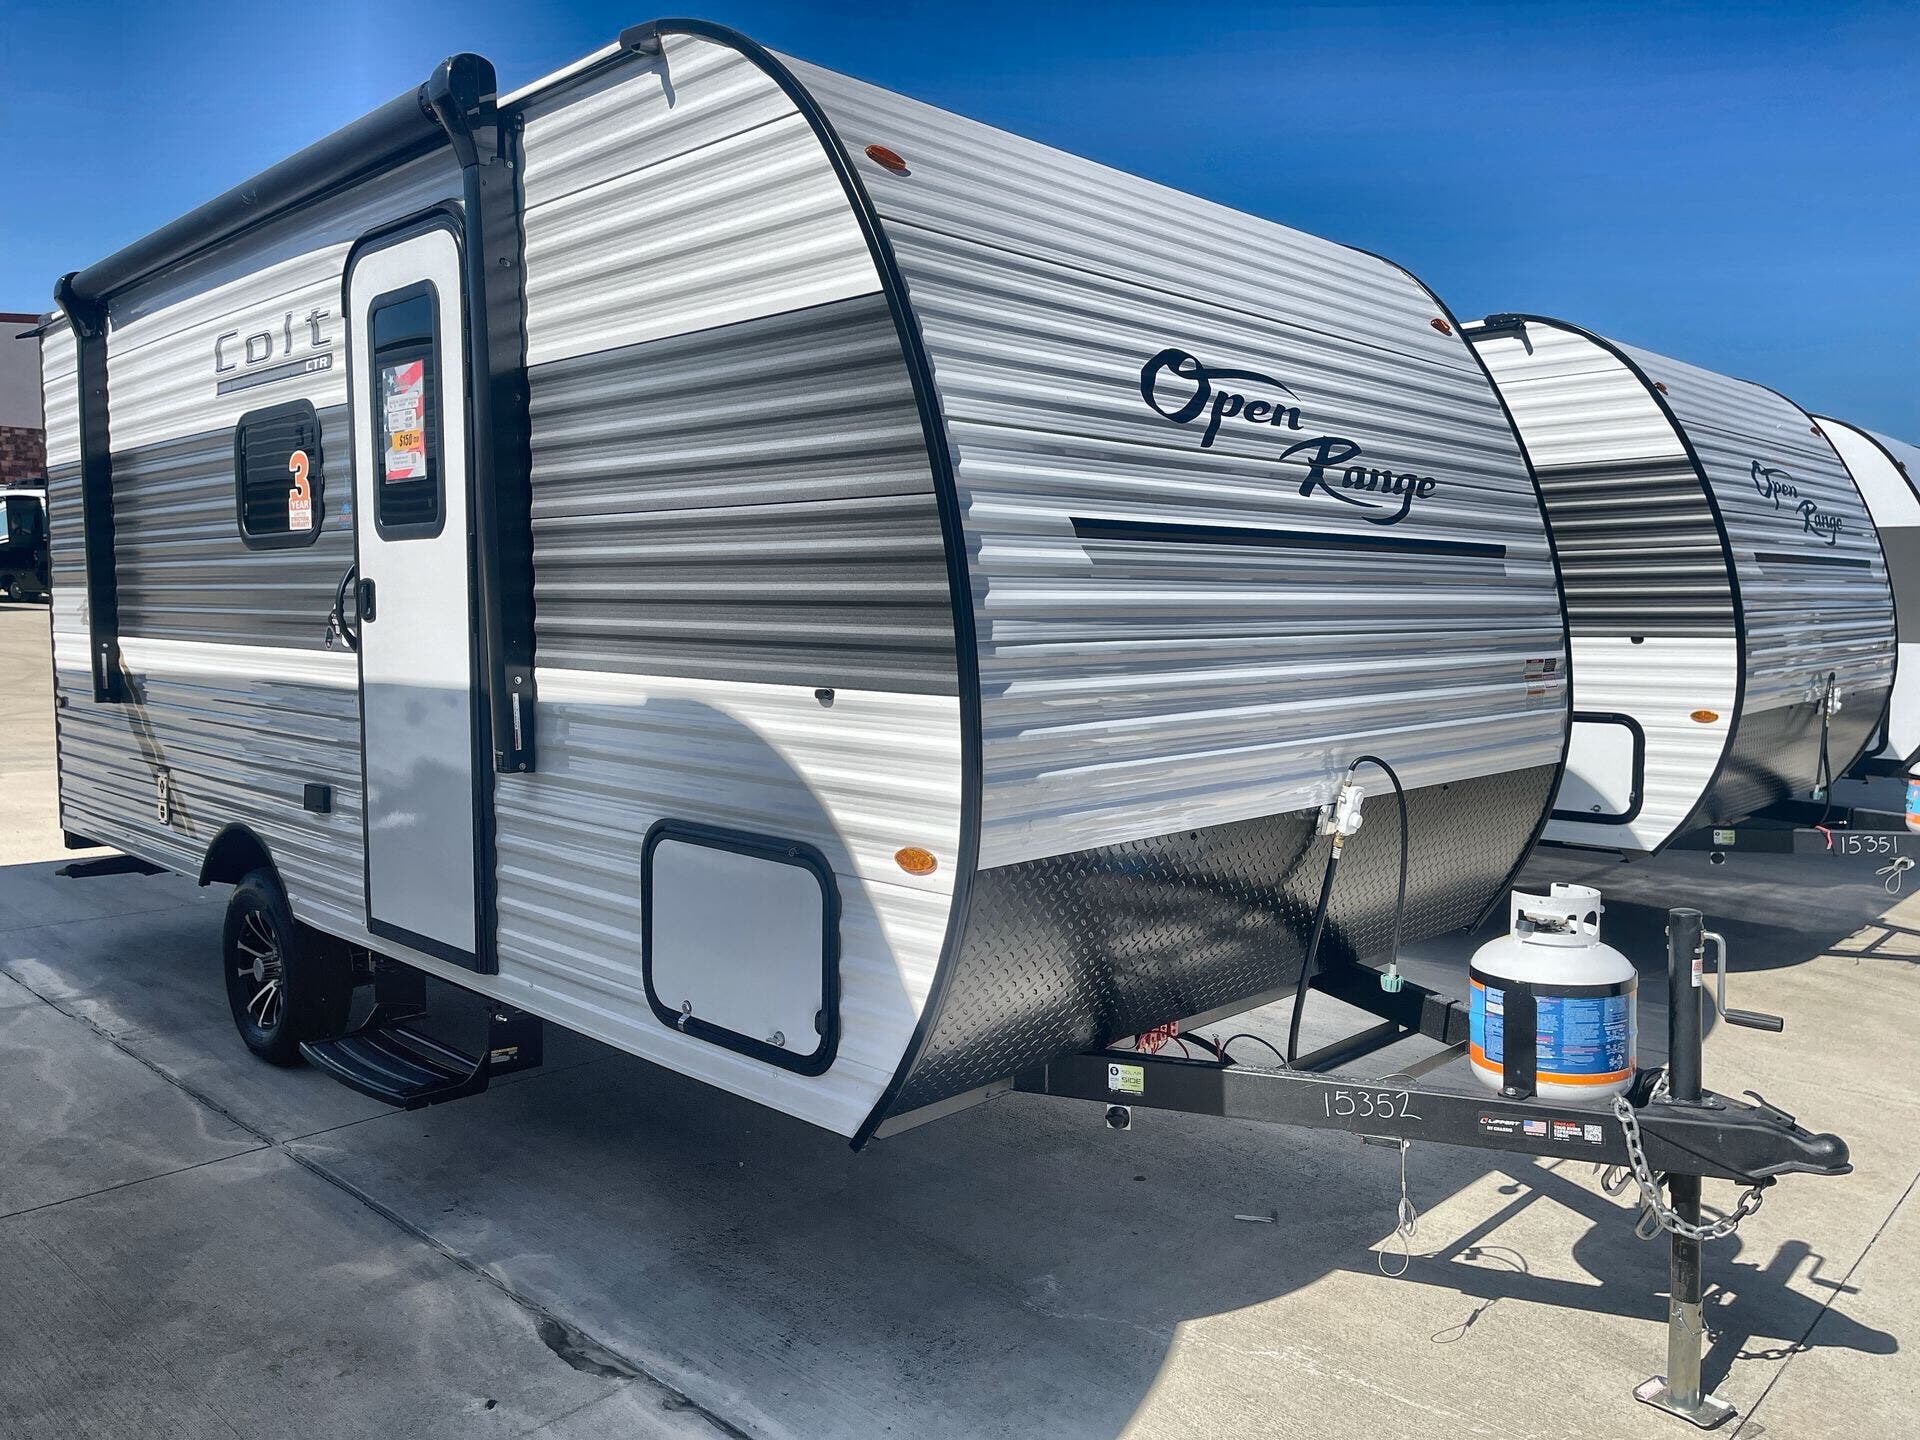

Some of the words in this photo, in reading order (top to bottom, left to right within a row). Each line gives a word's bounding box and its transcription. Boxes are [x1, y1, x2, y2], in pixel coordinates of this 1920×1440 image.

[215, 308, 332, 375] Colt
[305, 357, 328, 371] CTR
[1141, 348, 1304, 447] Open
[399, 433, 413, 447] $150
[289, 450, 310, 501] 3
[1279, 436, 1436, 526] Range
[1751, 460, 1798, 510] Open
[291, 500, 309, 510] YEAR
[1796, 499, 1843, 545] Range
[1841, 835, 1898, 854] 15351
[1121, 1076, 1142, 1085] SIDE
[1324, 1091, 1422, 1120] 15352
